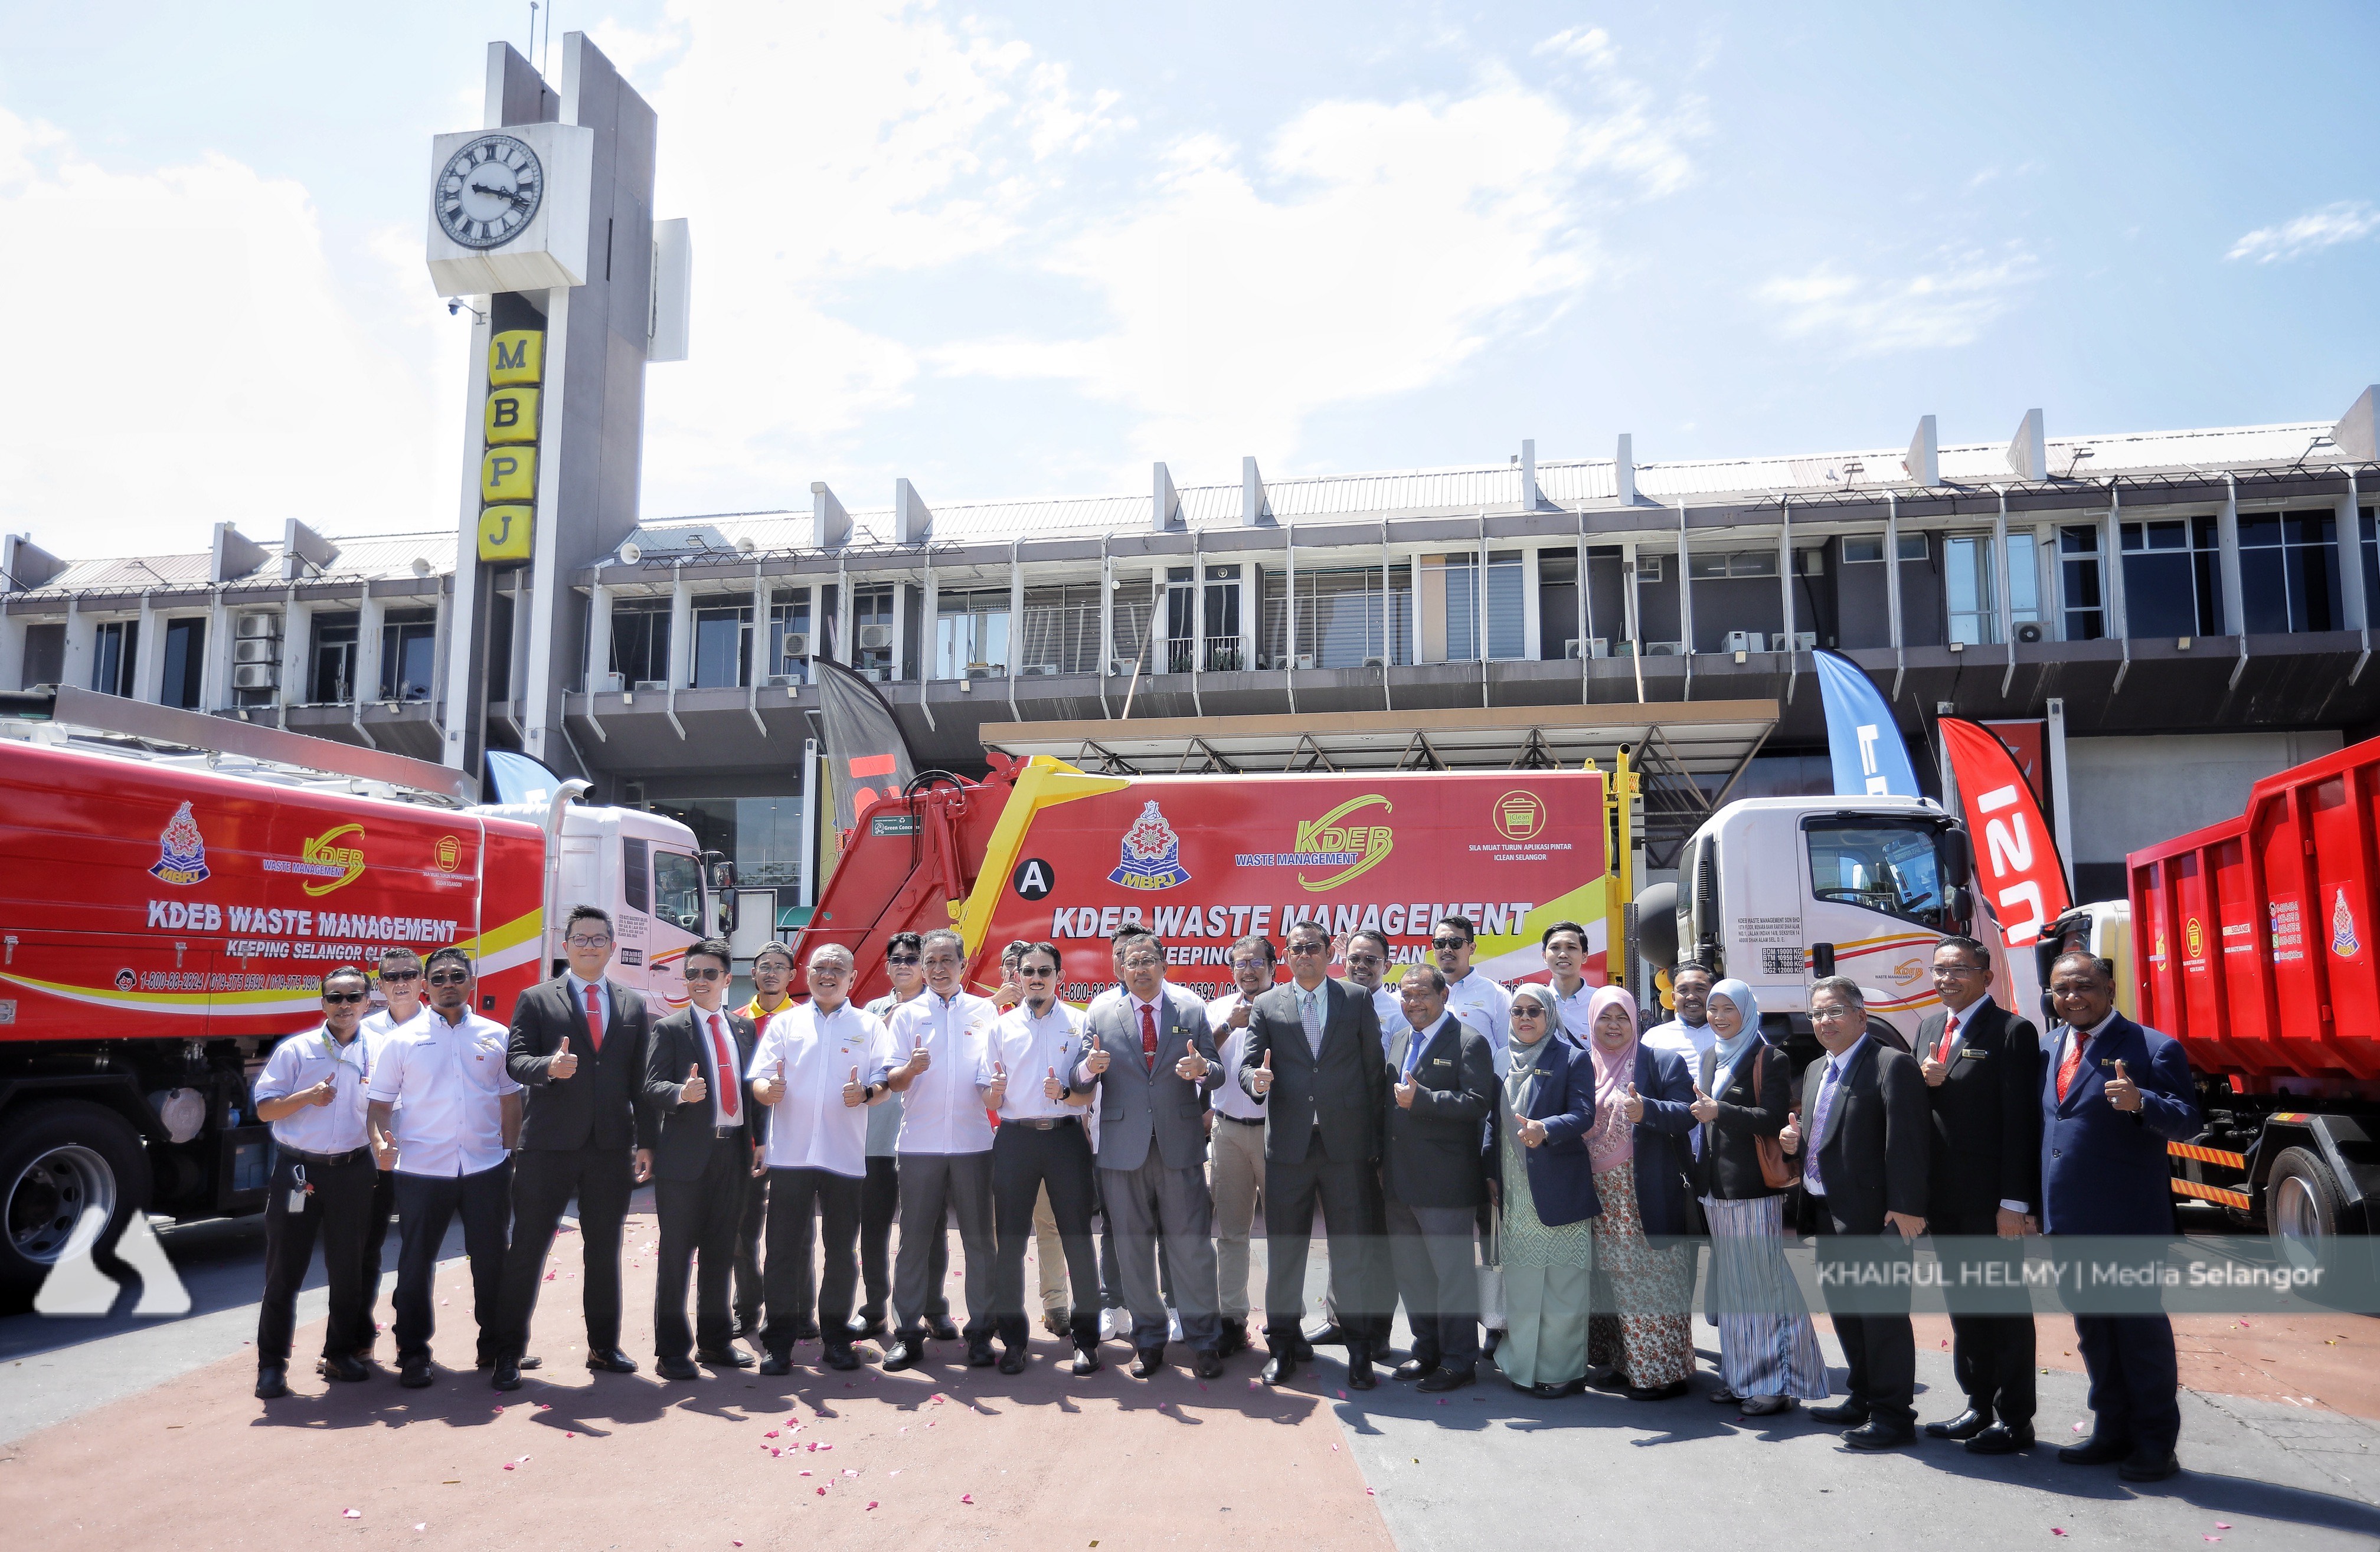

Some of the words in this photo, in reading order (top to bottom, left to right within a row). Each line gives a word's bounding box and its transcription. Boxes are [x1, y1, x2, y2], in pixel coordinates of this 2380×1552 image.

[1294, 811, 1393, 869] KDEB
[264, 860, 290, 872] WASTE
[292, 862, 345, 877] MANAGEMENT
[1235, 853, 1274, 866] WASTE
[1276, 852, 1358, 866] MANAGEMENT
[158, 868, 199, 883] MBPJ
[1019, 861, 1047, 893] A
[1121, 872, 1177, 888] MBPJ
[148, 900, 222, 931] KDEB
[228, 905, 312, 936] WASTE
[318, 912, 457, 943] MANAGEMENT
[1153, 905, 1271, 938] WASTE
[1280, 902, 1533, 937] MANAGEMENT
[225, 939, 290, 959] KEEPING
[293, 942, 362, 961] SELANGOR
[2336, 945, 2355, 955] MBPJ
[140, 971, 204, 990] 1-800-88-2824
[210, 974, 244, 990] 019-375
[244, 974, 265, 990] 9592
[270, 974, 301, 991] 019-375
[302, 975, 321, 991] 3980
